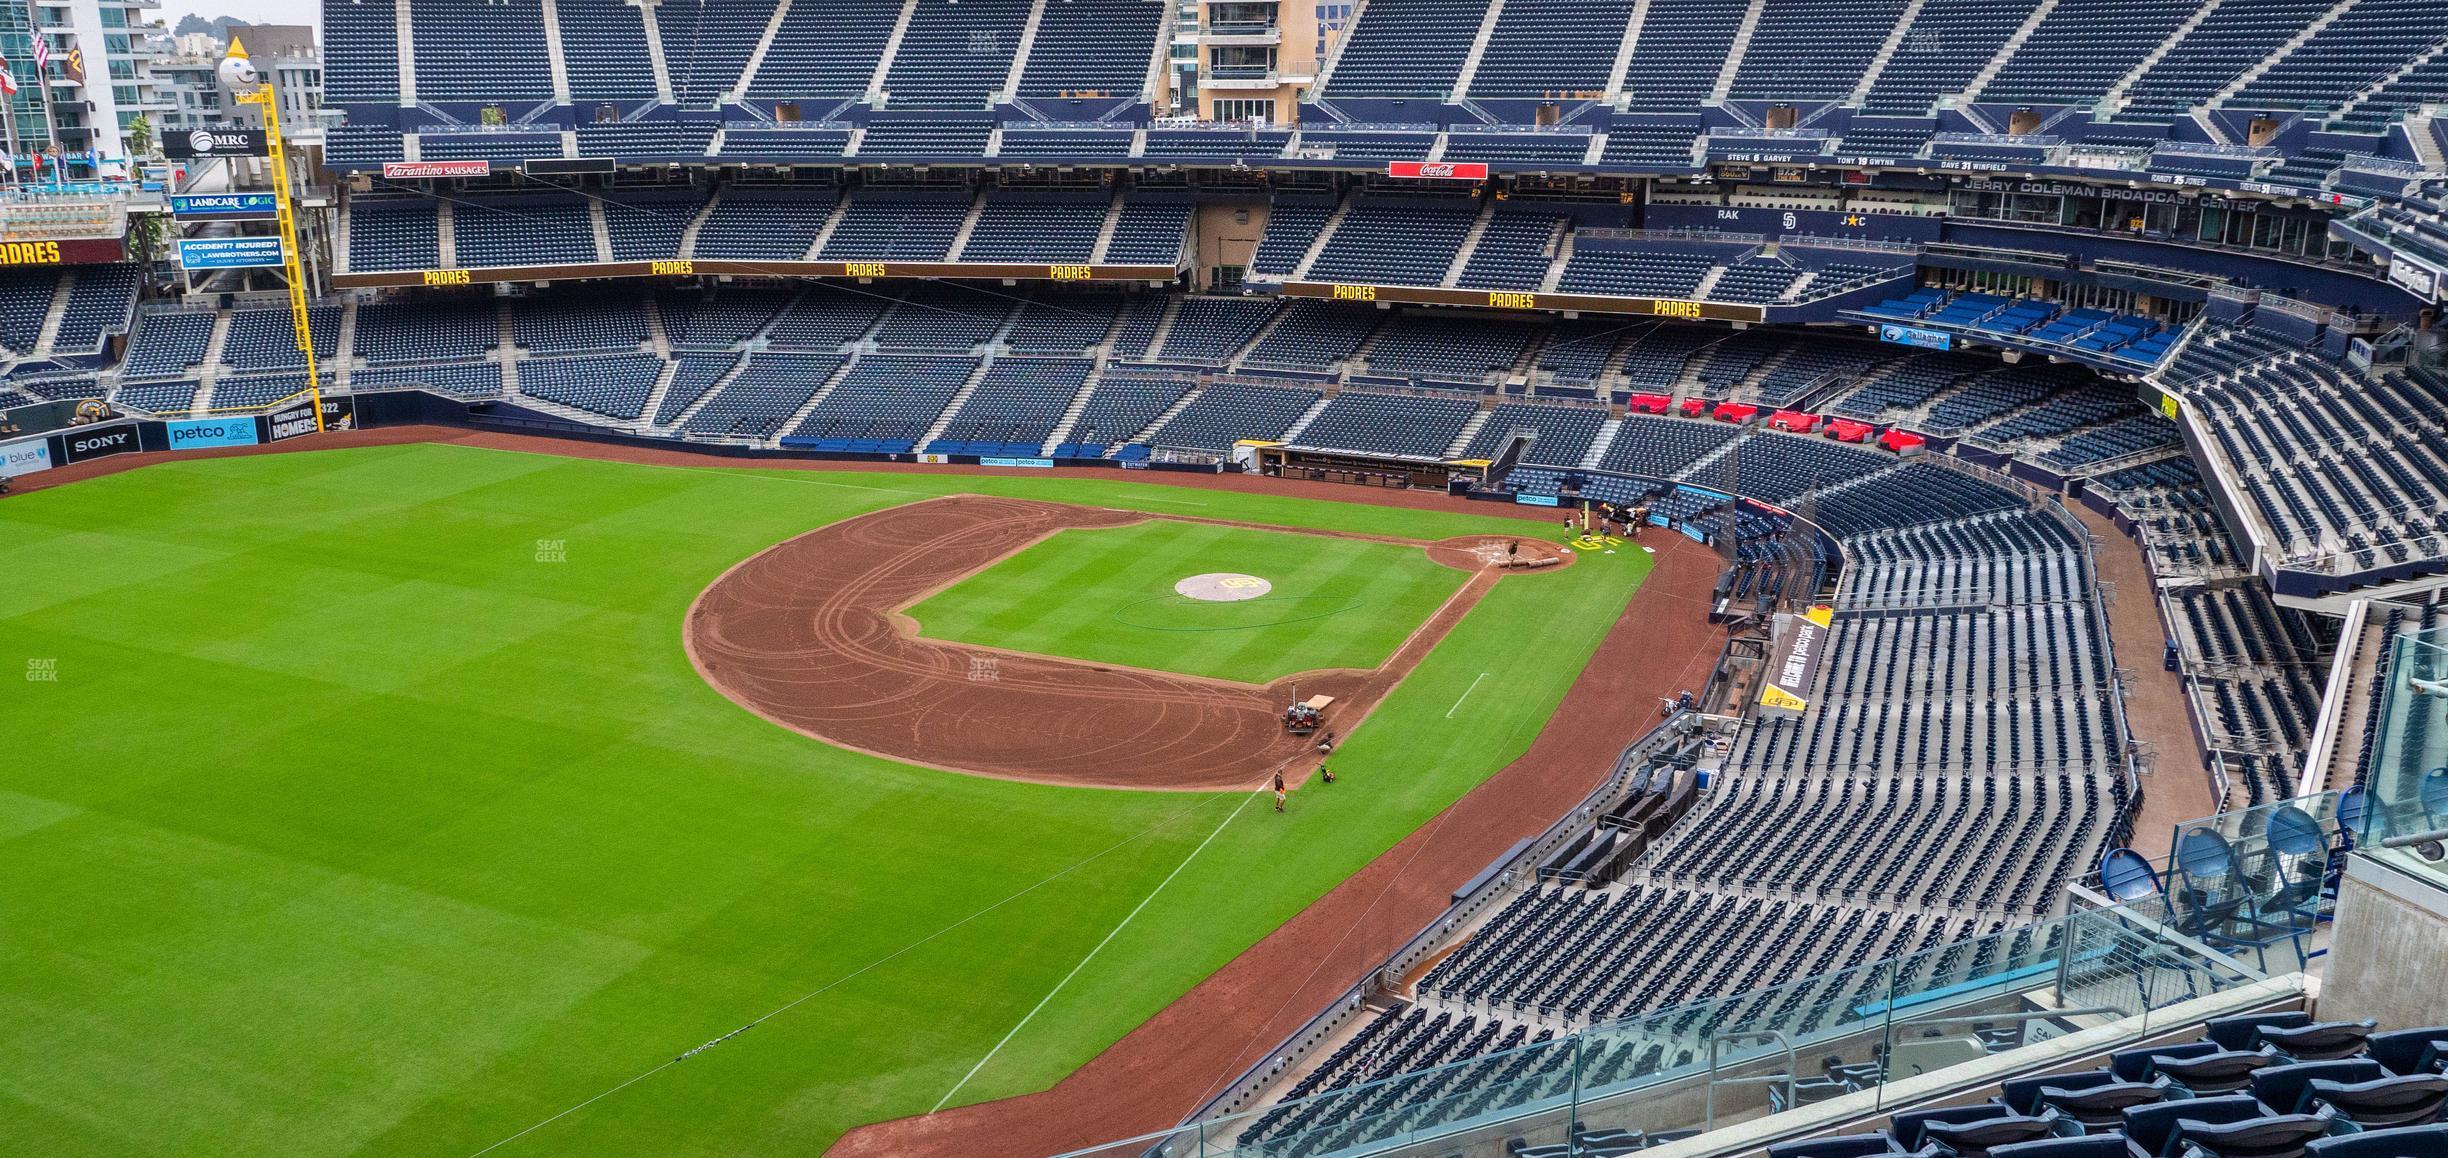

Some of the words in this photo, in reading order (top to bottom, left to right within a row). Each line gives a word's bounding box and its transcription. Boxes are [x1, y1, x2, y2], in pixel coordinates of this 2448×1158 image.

[213, 135, 249, 145] MRC
[1753, 154, 1760, 162] 6
[1763, 155, 1792, 163] GARVEY
[1837, 157, 1856, 165] TONY
[1858, 157, 1868, 166] 19
[1869, 158, 1895, 166] GWYNN
[387, 164, 442, 177] Tarantino
[444, 166, 487, 175] SAUSAGES
[1941, 161, 1960, 169] DAVE
[1961, 161, 1971, 170] 31
[1972, 162, 2007, 171] WINFIELD
[2173, 175, 2185, 185] 35
[2184, 177, 2207, 186] JONES
[1964, 180, 2014, 192] JERRY
[2020, 182, 2096, 198] COLEMAN
[2101, 188, 2193, 206] BROADCAST
[2200, 196, 2258, 212] CENTER
[2260, 184, 2272, 194] 51
[189, 197, 240, 207] LANDCARE
[243, 196, 275, 206] LOGIC
[1718, 209, 1739, 220] RAK
[0, 241, 61, 265] ADRES
[183, 243, 233, 251] ACCIDENT?
[235, 241, 278, 249] INJURED?
[201, 250, 279, 259] LAWBROTHERS.COM
[652, 260, 693, 275] PADRES
[846, 263, 885, 277] PADRES
[1051, 265, 1092, 279] PADRES
[424, 270, 470, 285] PADRES
[1334, 284, 1375, 300] PADRES
[1489, 292, 1534, 309] PADRES
[1654, 299, 1701, 318] PADRES
[320, 402, 340, 414] 322
[273, 410, 299, 424] HUNGRY
[299, 407, 313, 418] FOR
[173, 424, 225, 443] petco
[272, 416, 318, 440] HOMERS
[74, 433, 128, 453] SONY
[9, 451, 36, 464] blue
[1797, 624, 1816, 641] park
[1791, 638, 1810, 657] petco
